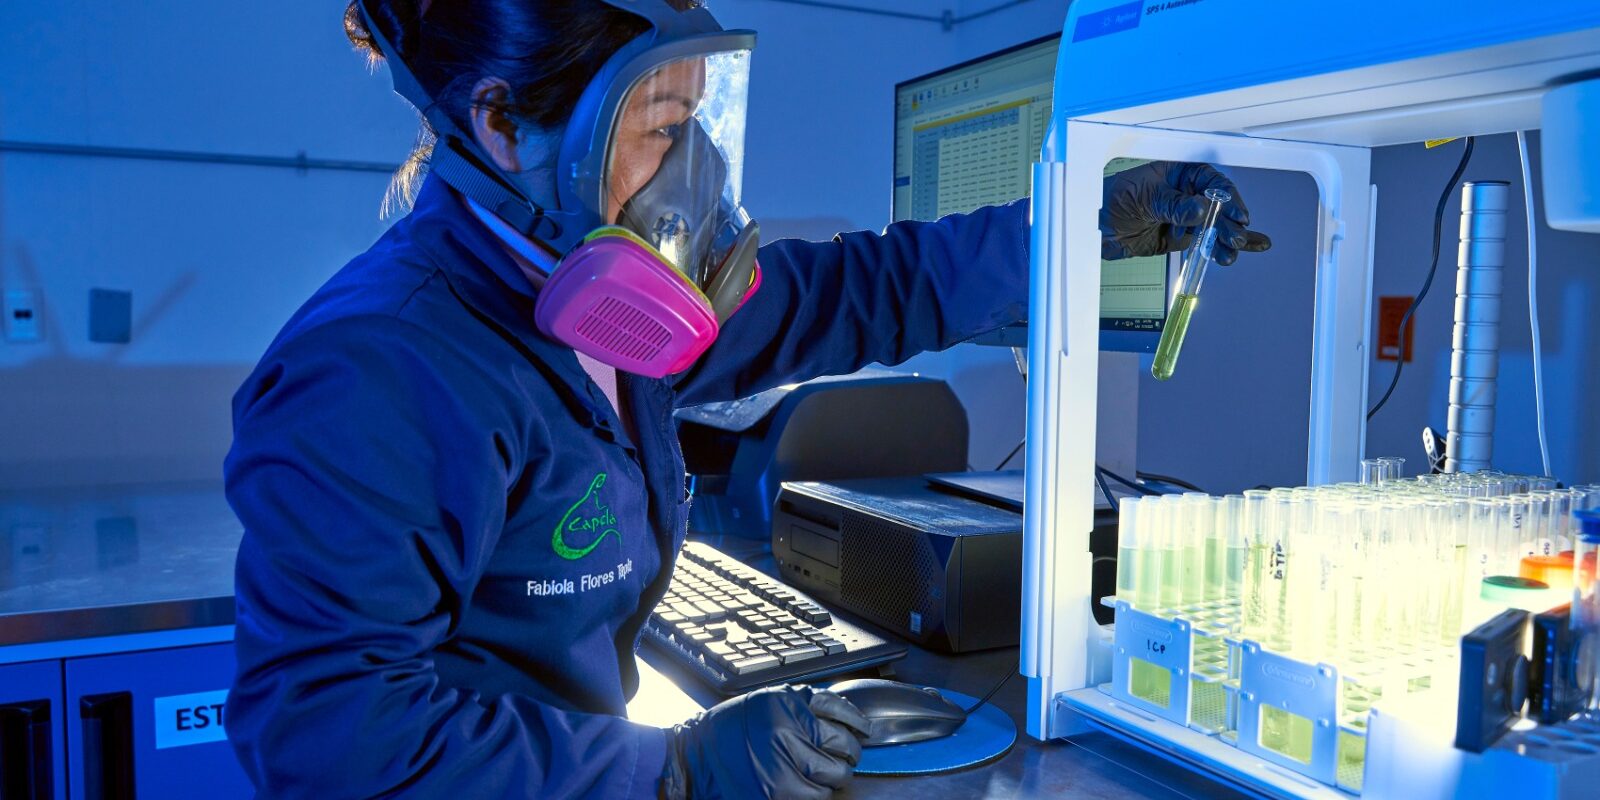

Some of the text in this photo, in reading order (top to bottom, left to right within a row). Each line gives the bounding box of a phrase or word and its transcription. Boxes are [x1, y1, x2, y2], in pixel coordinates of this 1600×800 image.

[1146, 5, 1160, 15] SPS
[526, 578, 575, 596] Fabiola
[580, 571, 615, 592] Flores
[176, 703, 225, 731] EST
